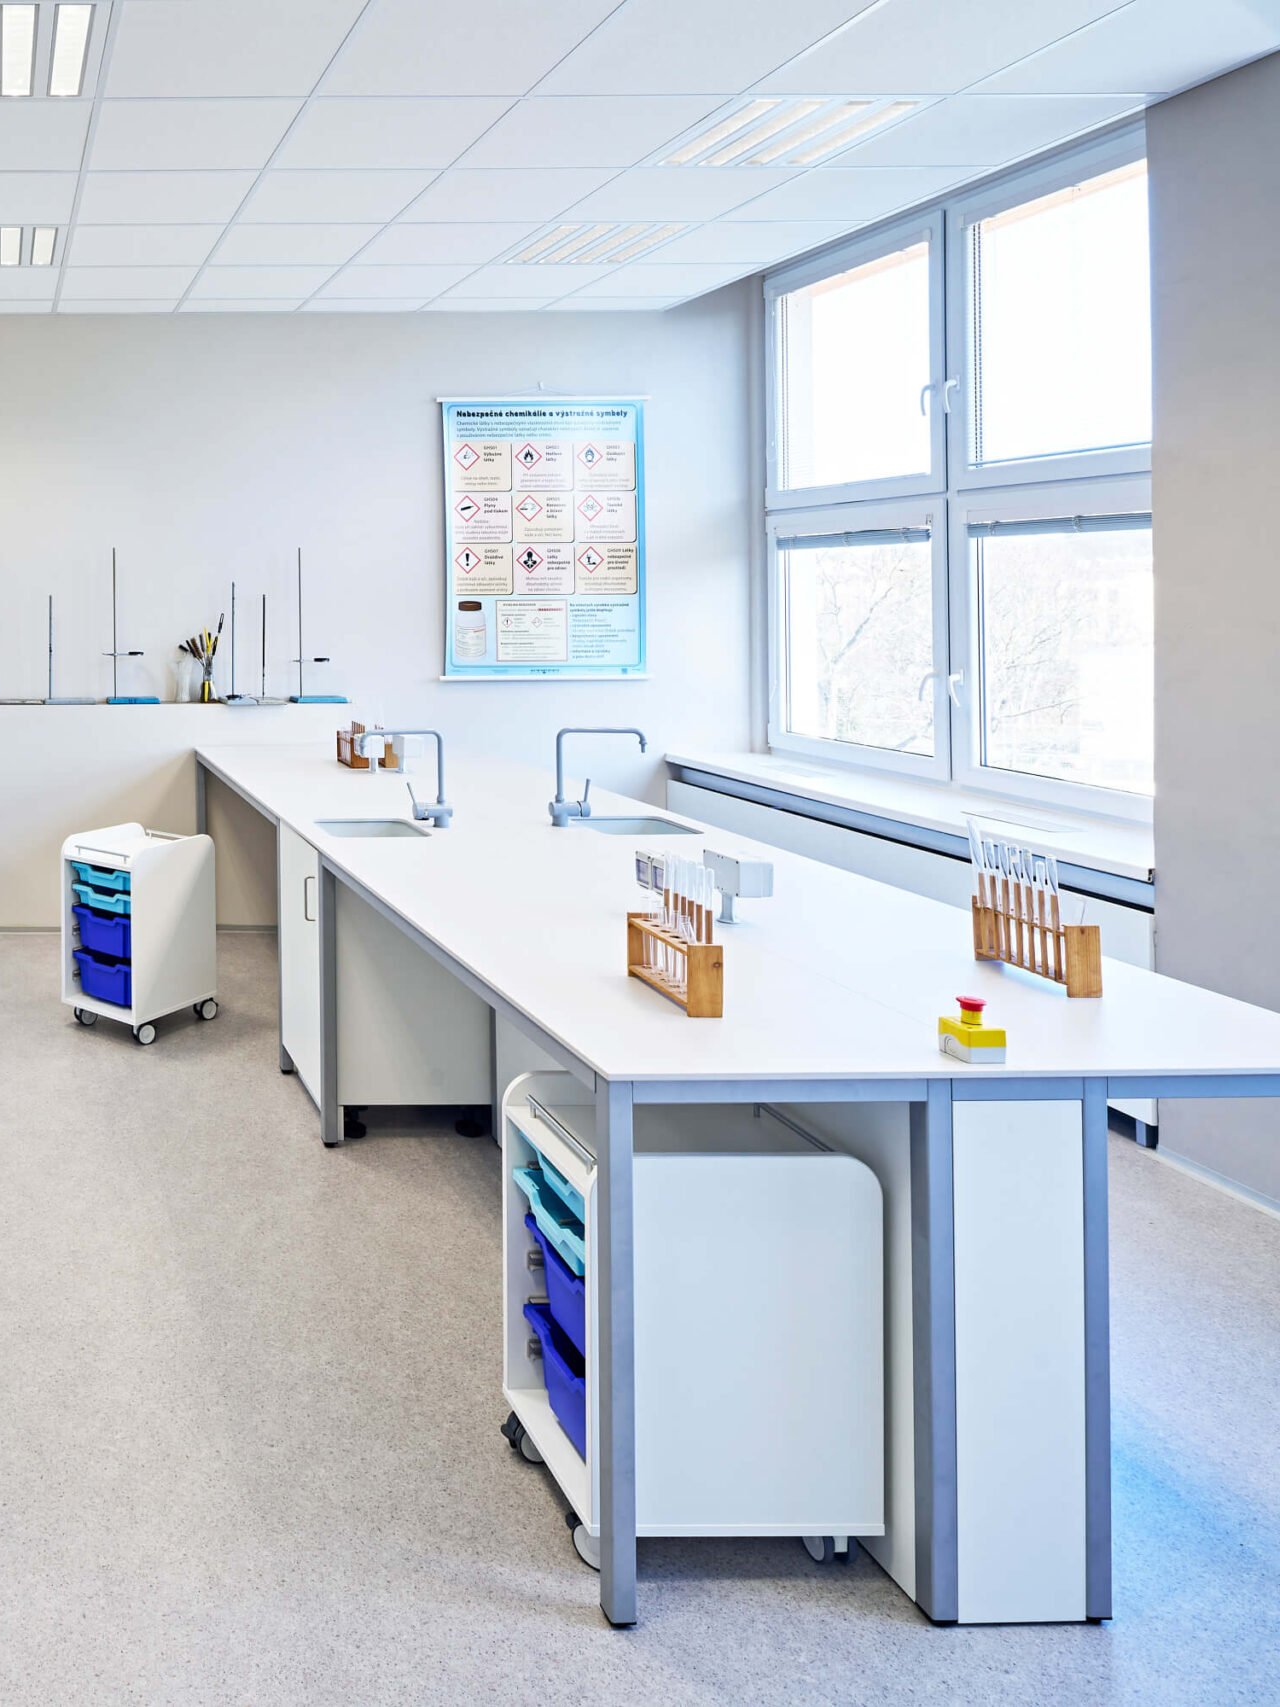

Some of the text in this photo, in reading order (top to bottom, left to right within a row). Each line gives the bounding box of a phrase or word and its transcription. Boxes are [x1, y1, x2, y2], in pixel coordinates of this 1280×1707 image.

[456, 410, 503, 419] Nebezpečné
[555, 410, 594, 419] výstražné
[596, 410, 628, 418] symboly
